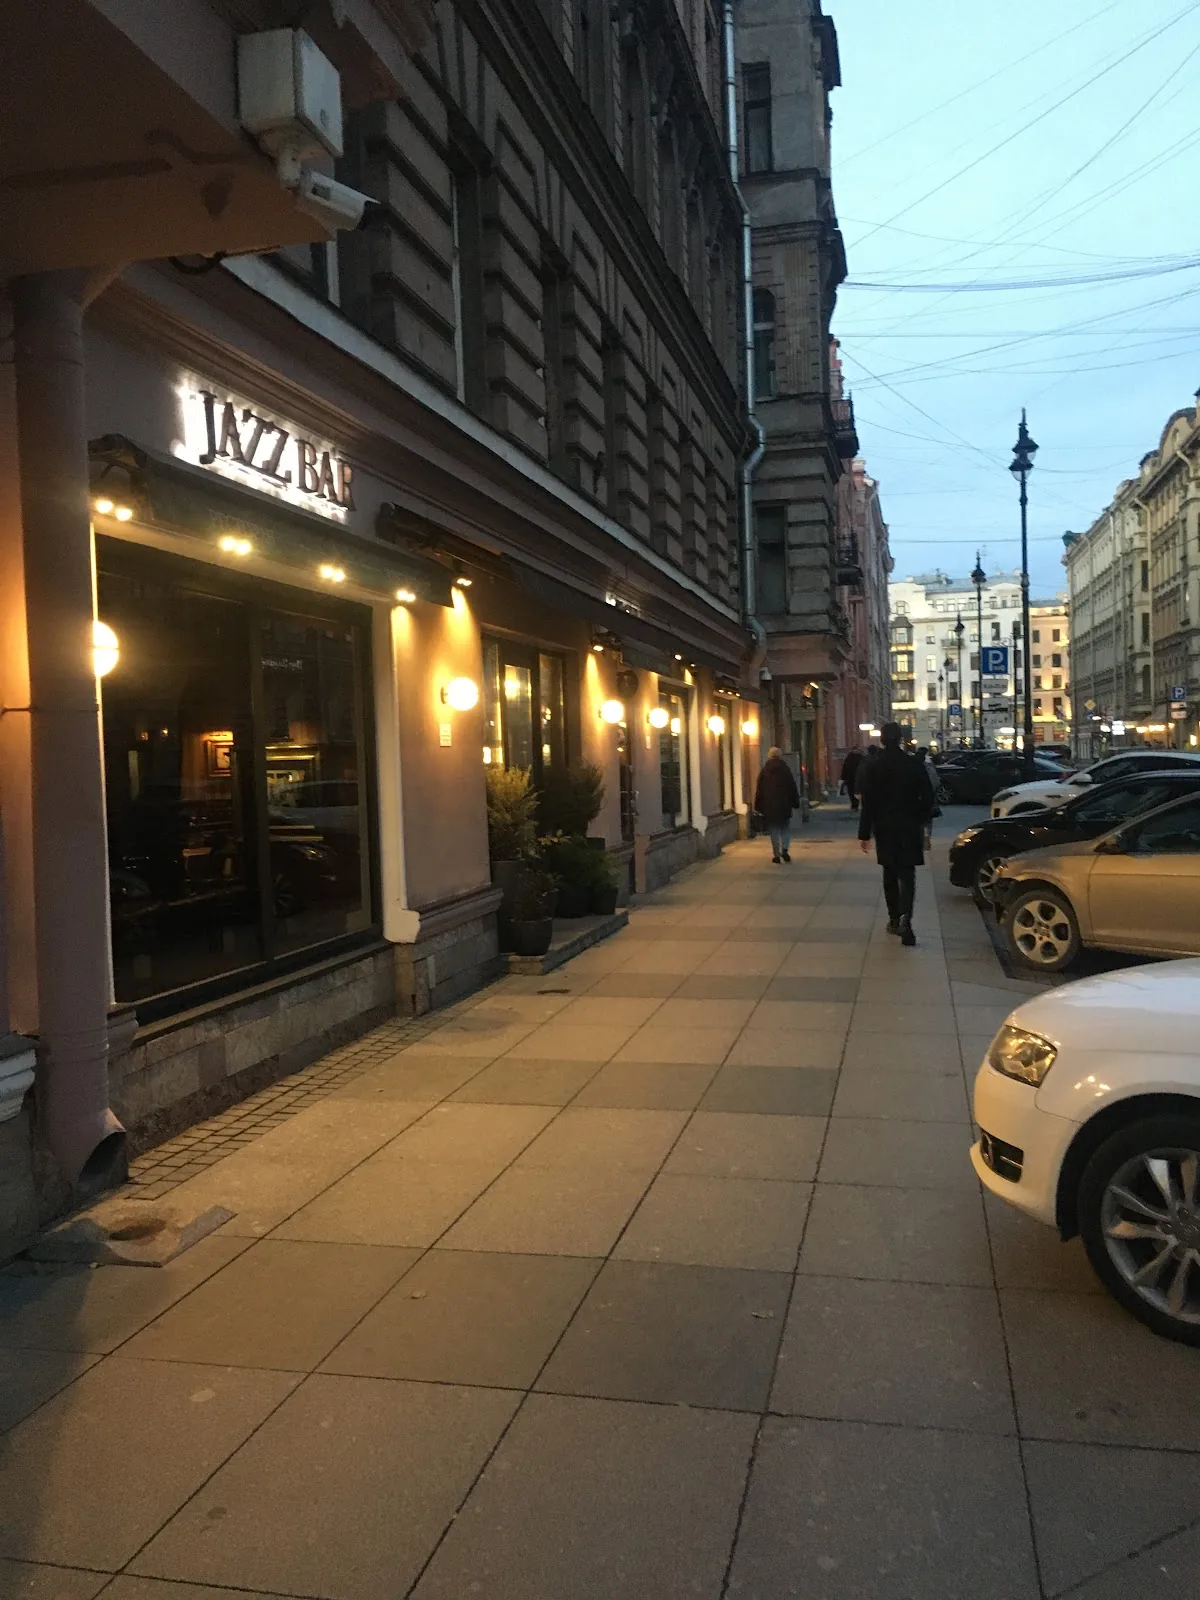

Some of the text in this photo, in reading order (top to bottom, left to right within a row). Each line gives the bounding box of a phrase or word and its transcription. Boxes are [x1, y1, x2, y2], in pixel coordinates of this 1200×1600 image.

[199, 390, 356, 511] JAZZ BAR
[988, 650, 1004, 672] P
